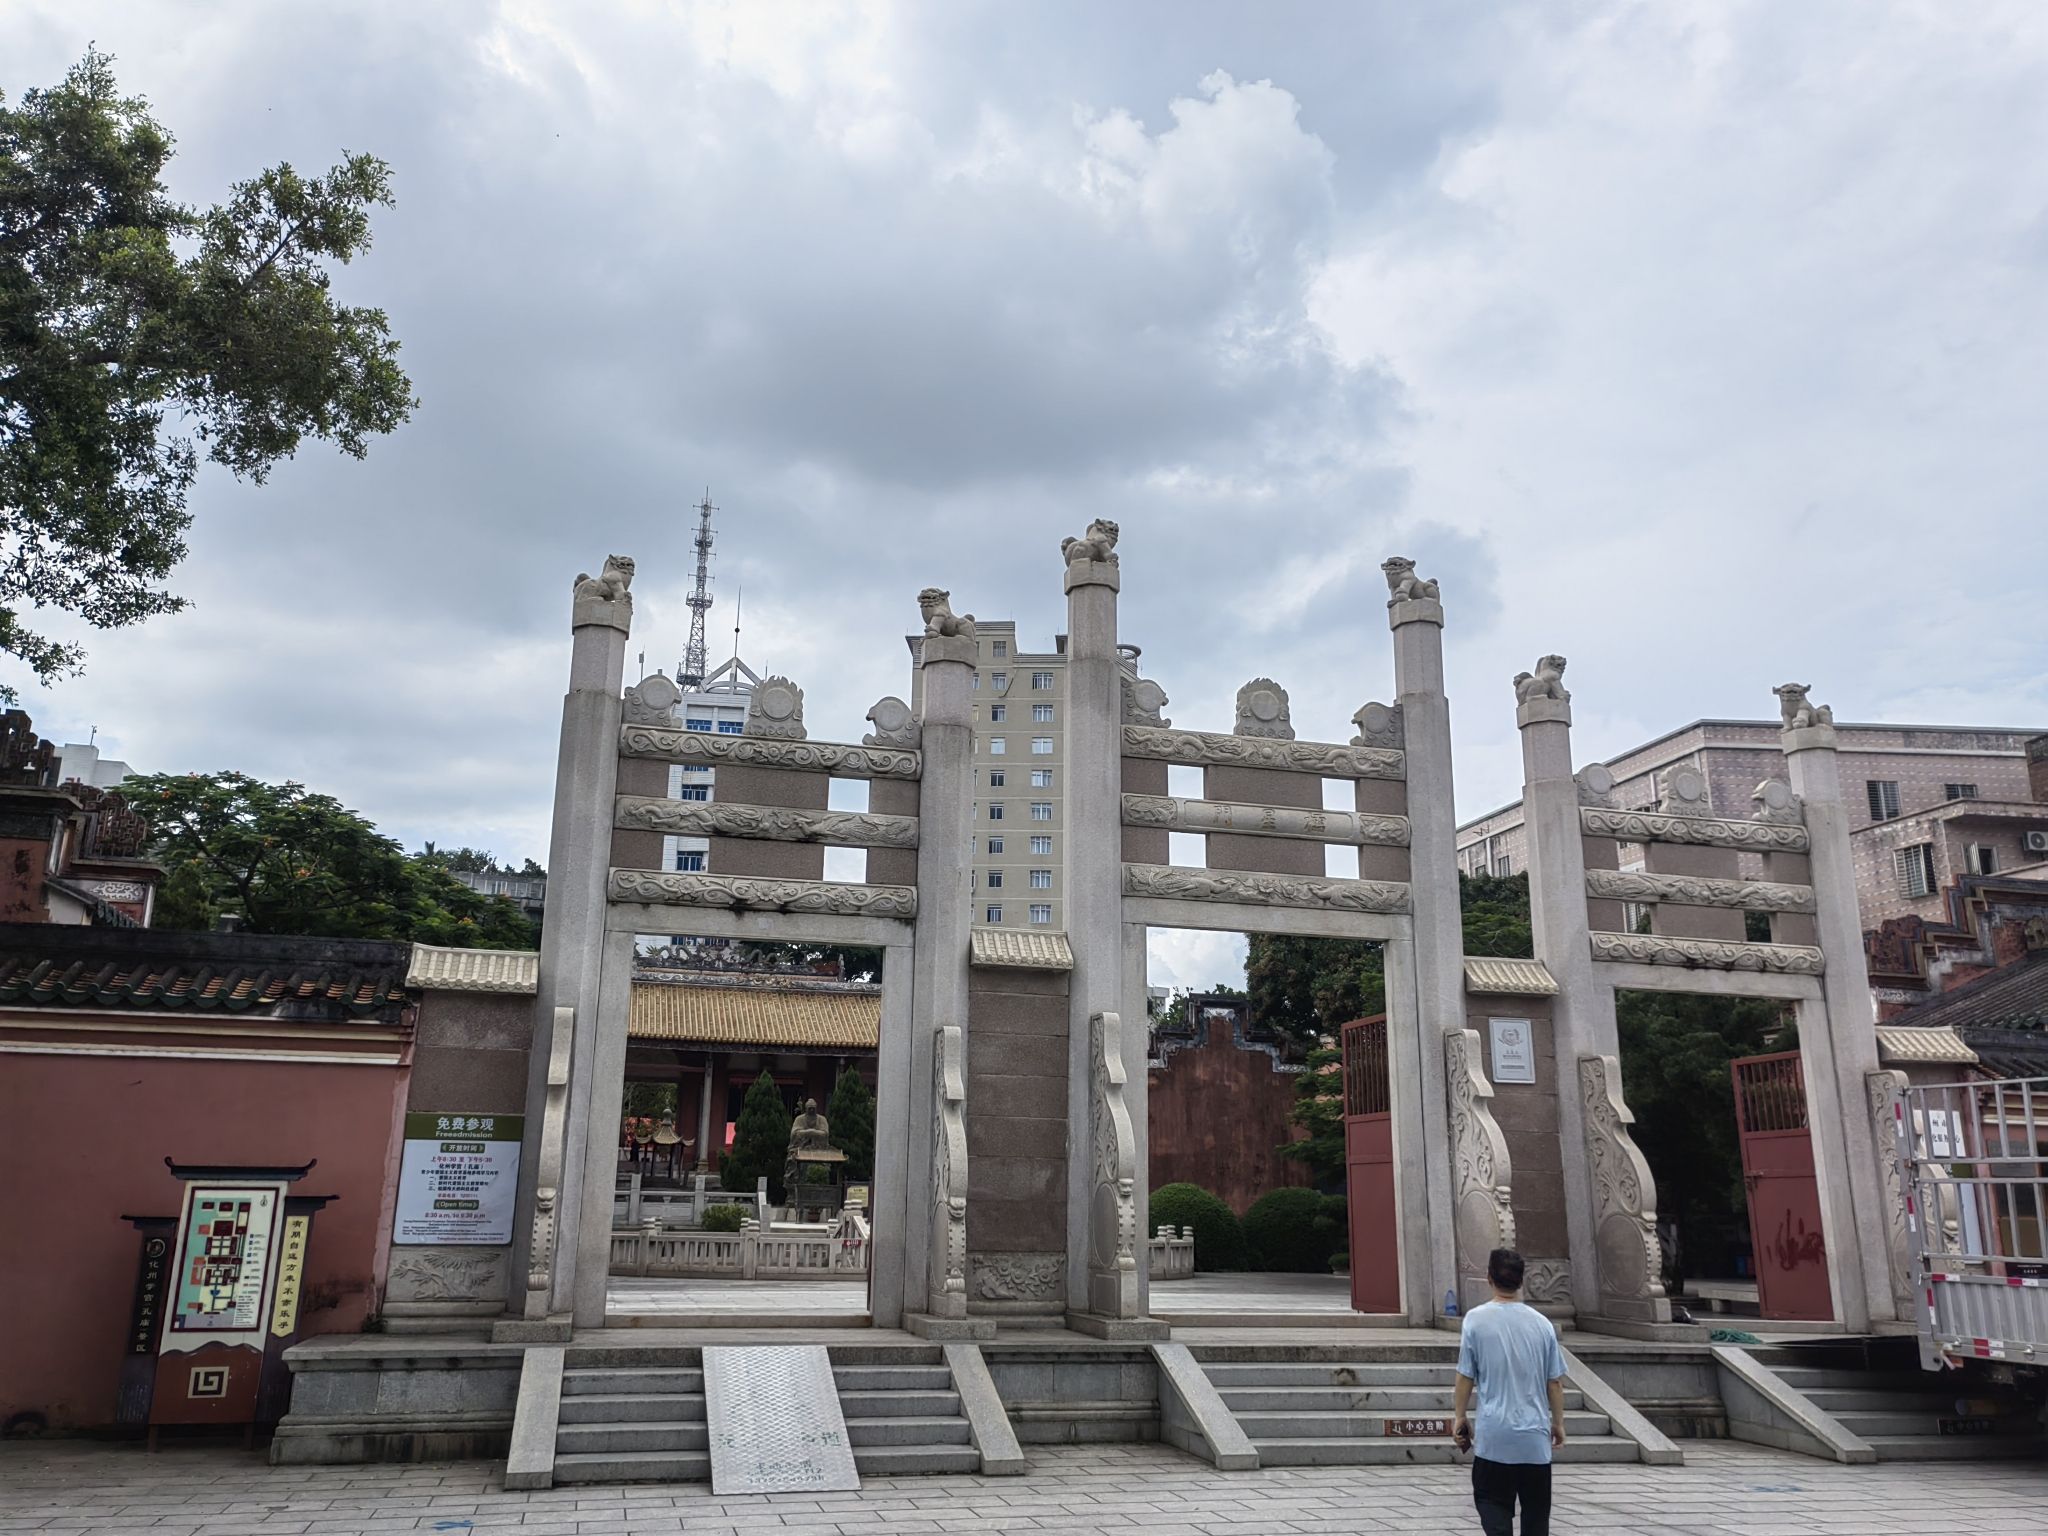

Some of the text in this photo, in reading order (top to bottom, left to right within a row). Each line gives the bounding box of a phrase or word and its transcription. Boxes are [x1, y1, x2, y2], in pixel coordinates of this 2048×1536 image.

[437, 1117, 494, 1130] 免费参观
[448, 1144, 478, 1152] 开放时间
[440, 1201, 457, 1209] Open
[278, 1220, 303, 1329] 有朋自远方来不亦乐乎
[1406, 1421, 1443, 1431] 小心台阶
